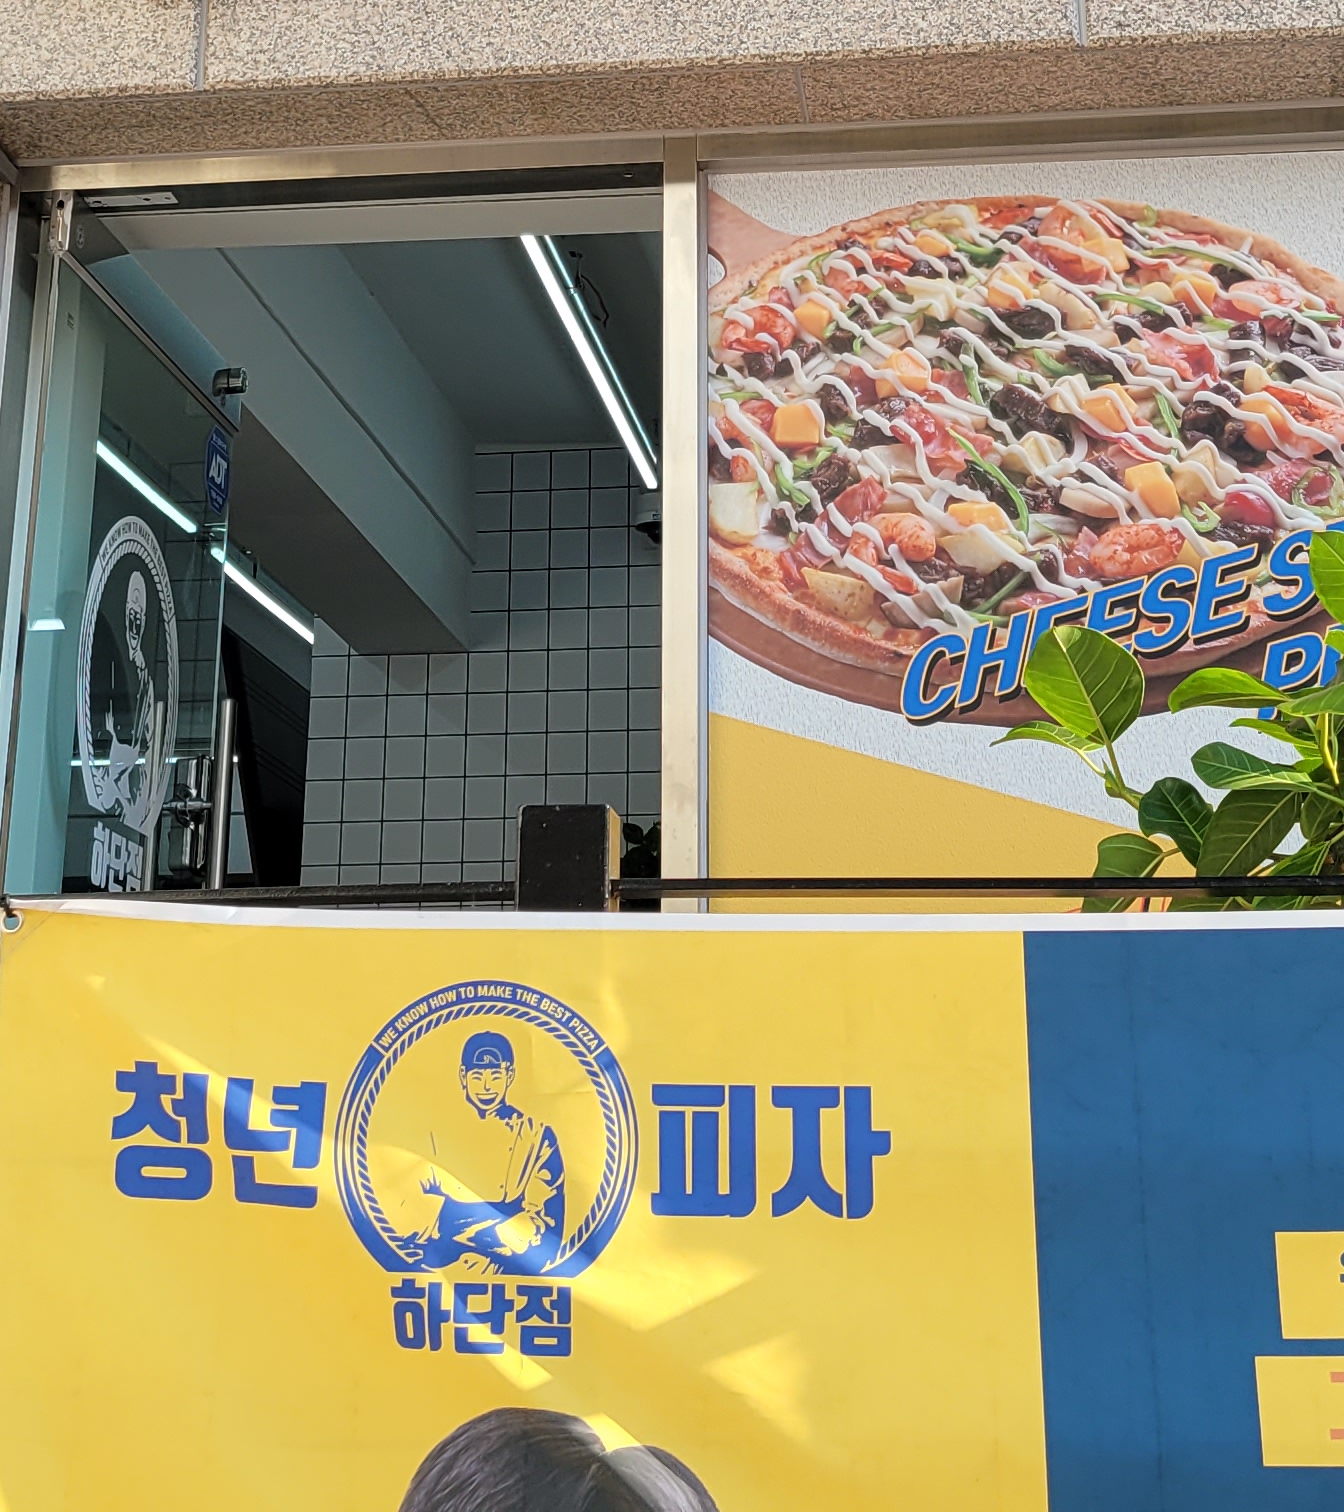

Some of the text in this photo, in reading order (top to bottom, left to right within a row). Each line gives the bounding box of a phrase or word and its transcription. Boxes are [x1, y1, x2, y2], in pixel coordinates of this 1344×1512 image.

[378, 984, 600, 1051] WE KNOW HOW TO MAKE THE BEST PIZZA
[110, 1060, 892, 1220] 청년 피자
[390, 1277, 572, 1359] 하단점
